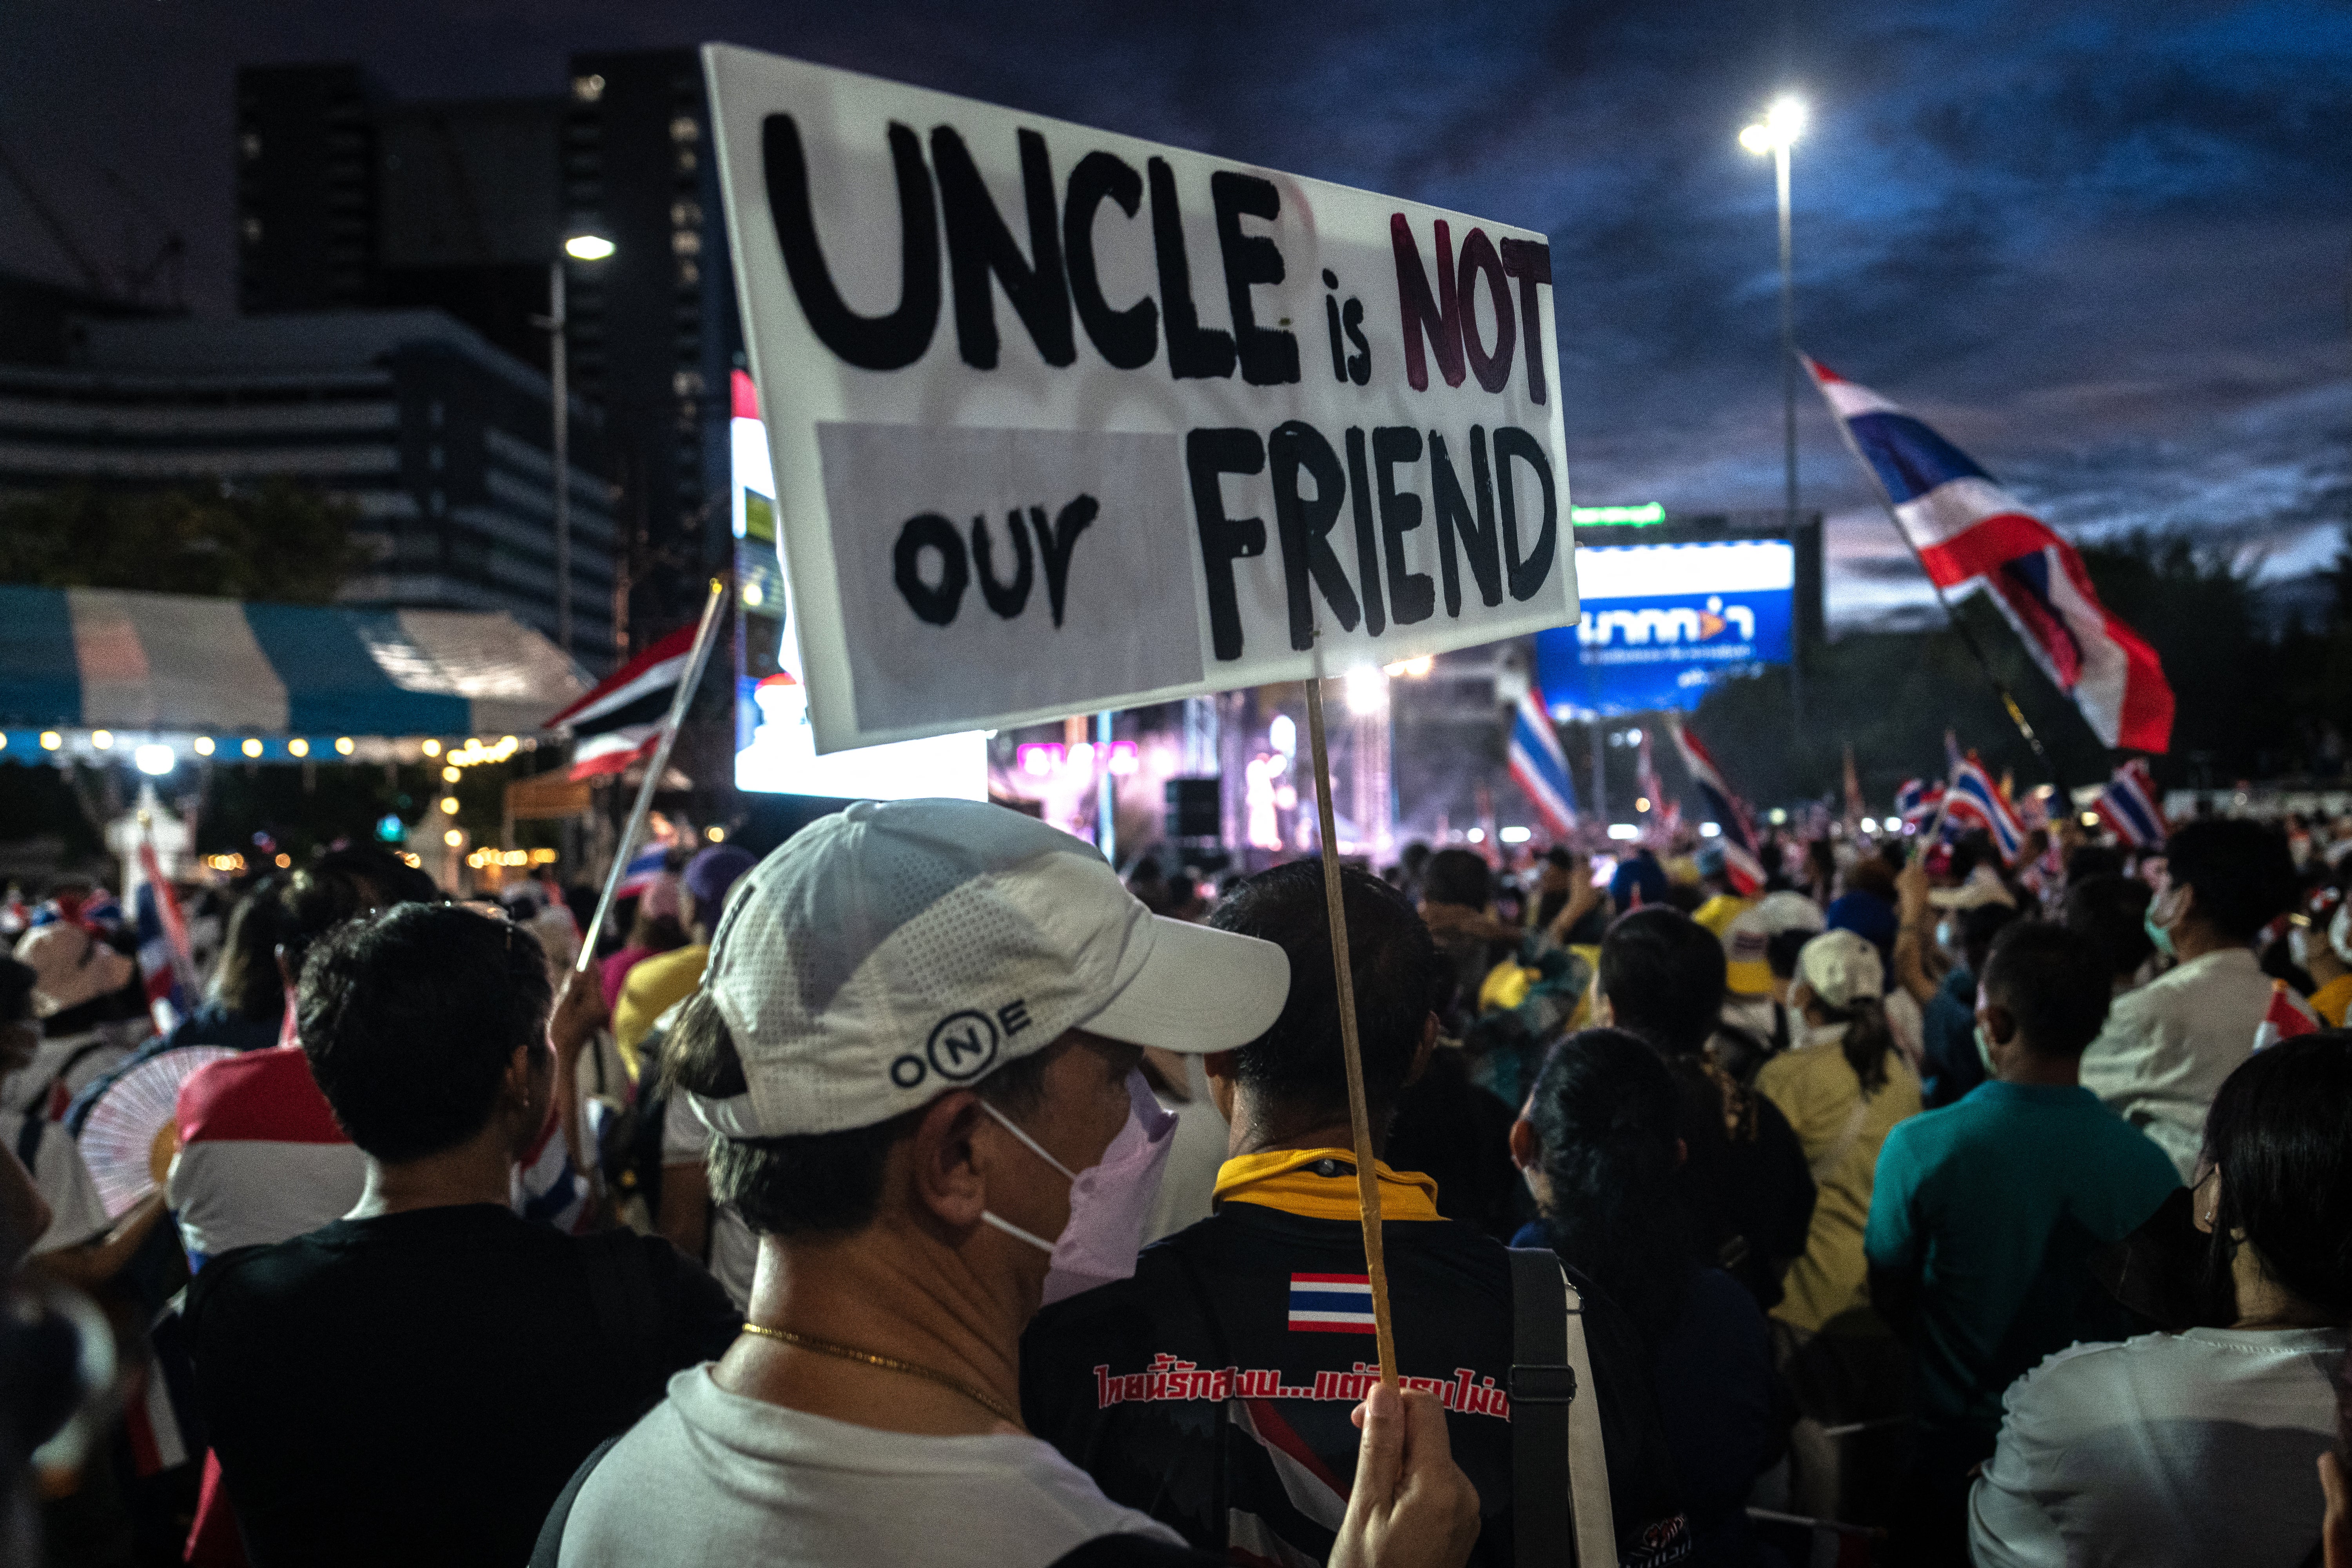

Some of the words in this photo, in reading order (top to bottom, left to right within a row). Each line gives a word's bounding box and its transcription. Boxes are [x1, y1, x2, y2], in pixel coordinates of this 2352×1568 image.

[763, 113, 1300, 385] UNCLE
[1321, 269, 1371, 384] is
[1390, 213, 1552, 404] NOT
[1186, 420, 1557, 661] FRIEND
[891, 999, 1031, 1089] ONE
